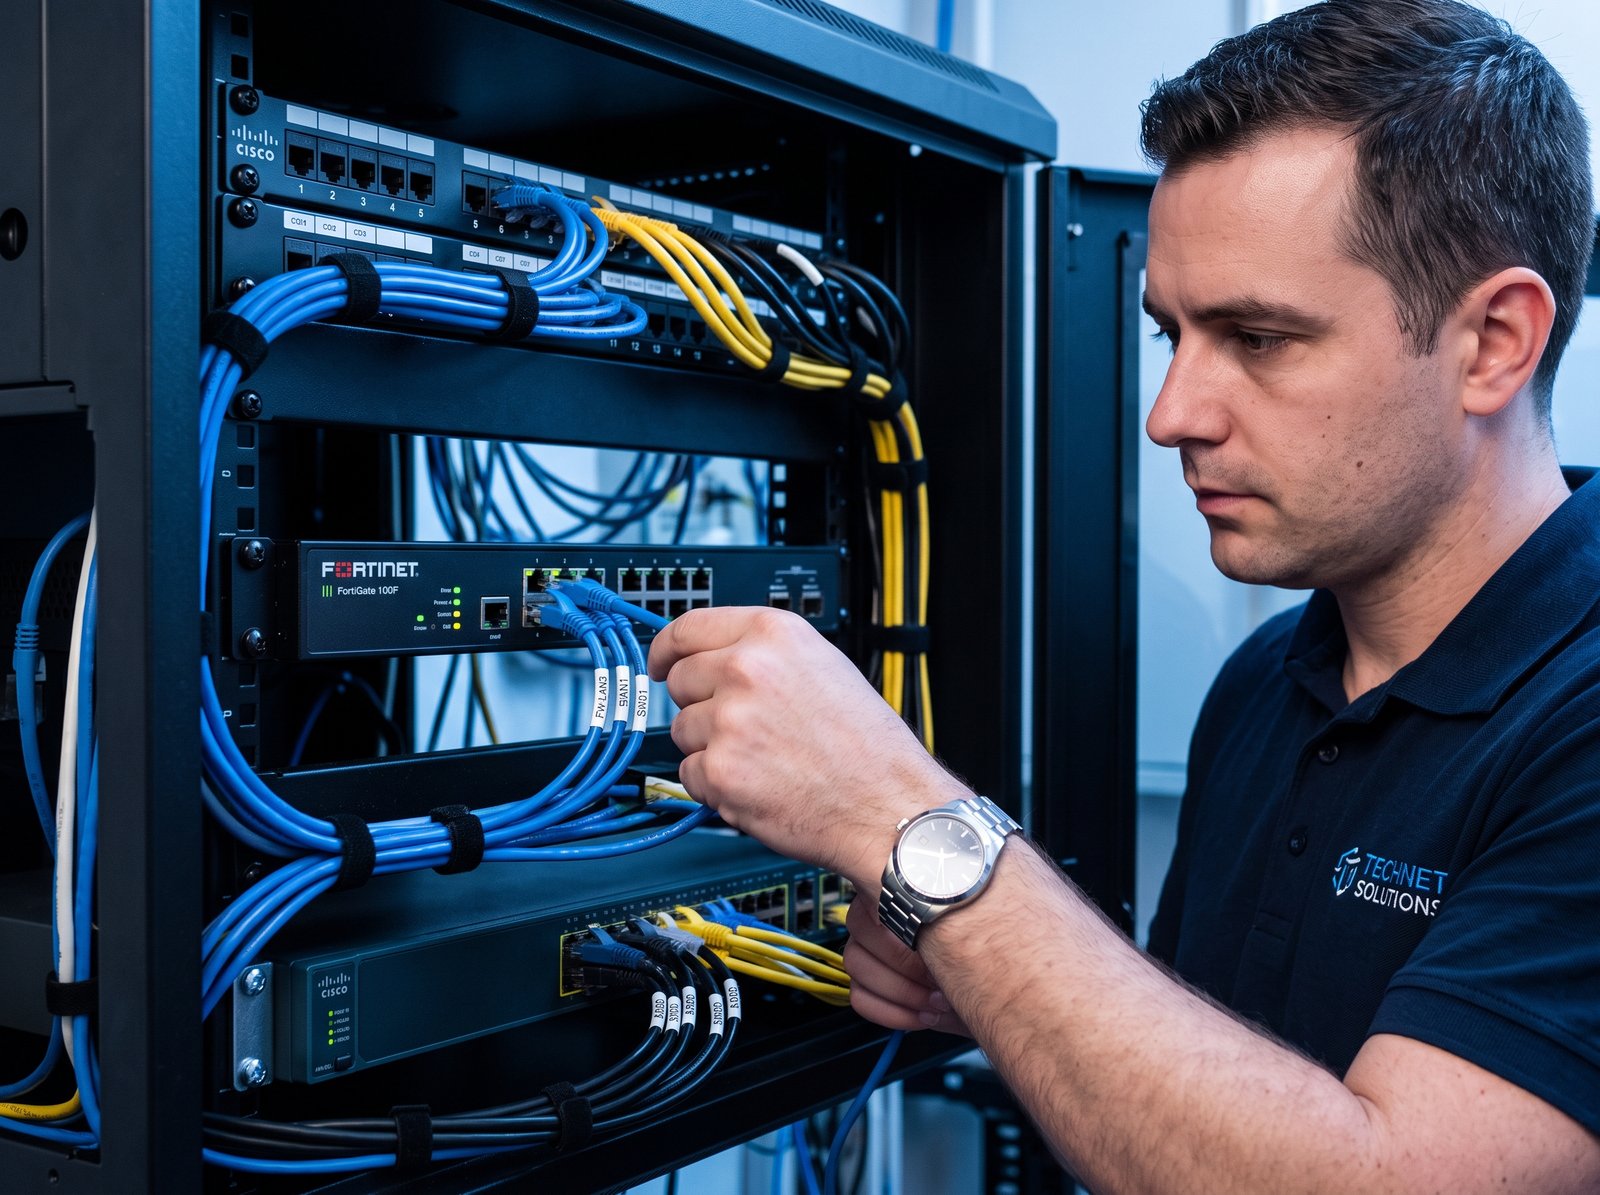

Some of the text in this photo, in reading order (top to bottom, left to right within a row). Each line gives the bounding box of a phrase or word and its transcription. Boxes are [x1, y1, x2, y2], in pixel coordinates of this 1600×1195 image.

[236, 143, 275, 162] CISCO
[299, 184, 304, 194] 1
[329, 191, 336, 200] 2
[360, 197, 366, 206] 3
[389, 203, 396, 212] 4
[418, 209, 424, 218] 5
[473, 220, 479, 229] 5
[498, 225, 504, 234] 6
[322, 561, 419, 578] FORTINET
[337, 586, 399, 596] FortiGate 100F
[1364, 853, 1448, 894] TECHNET
[321, 985, 348, 999] CISCO
